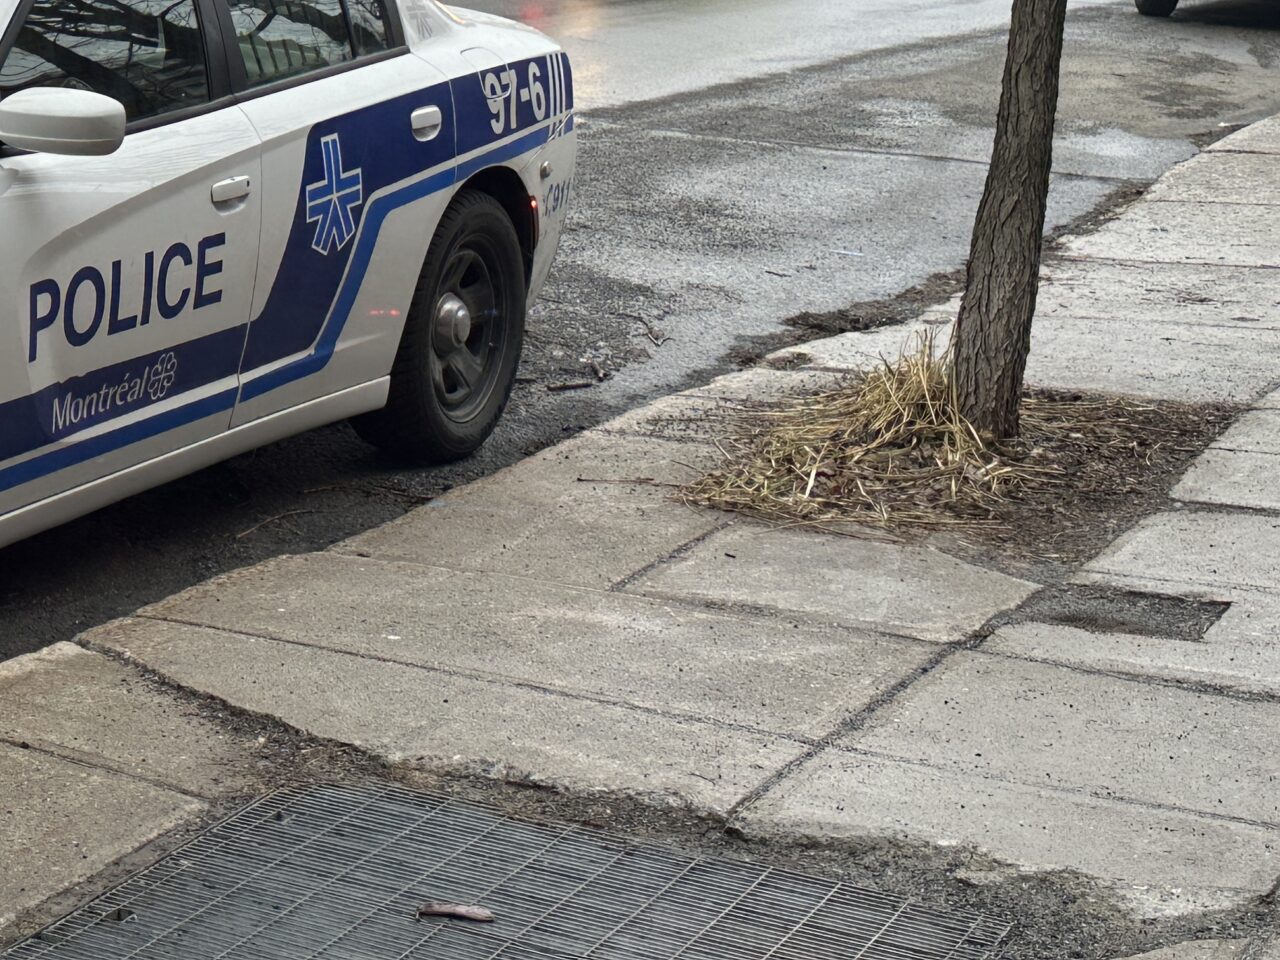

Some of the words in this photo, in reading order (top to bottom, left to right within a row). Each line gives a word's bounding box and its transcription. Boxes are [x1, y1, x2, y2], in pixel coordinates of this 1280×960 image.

[484, 61, 546, 135] 97-6
[28, 231, 226, 364] POLICE
[52, 366, 149, 433] Montréal
